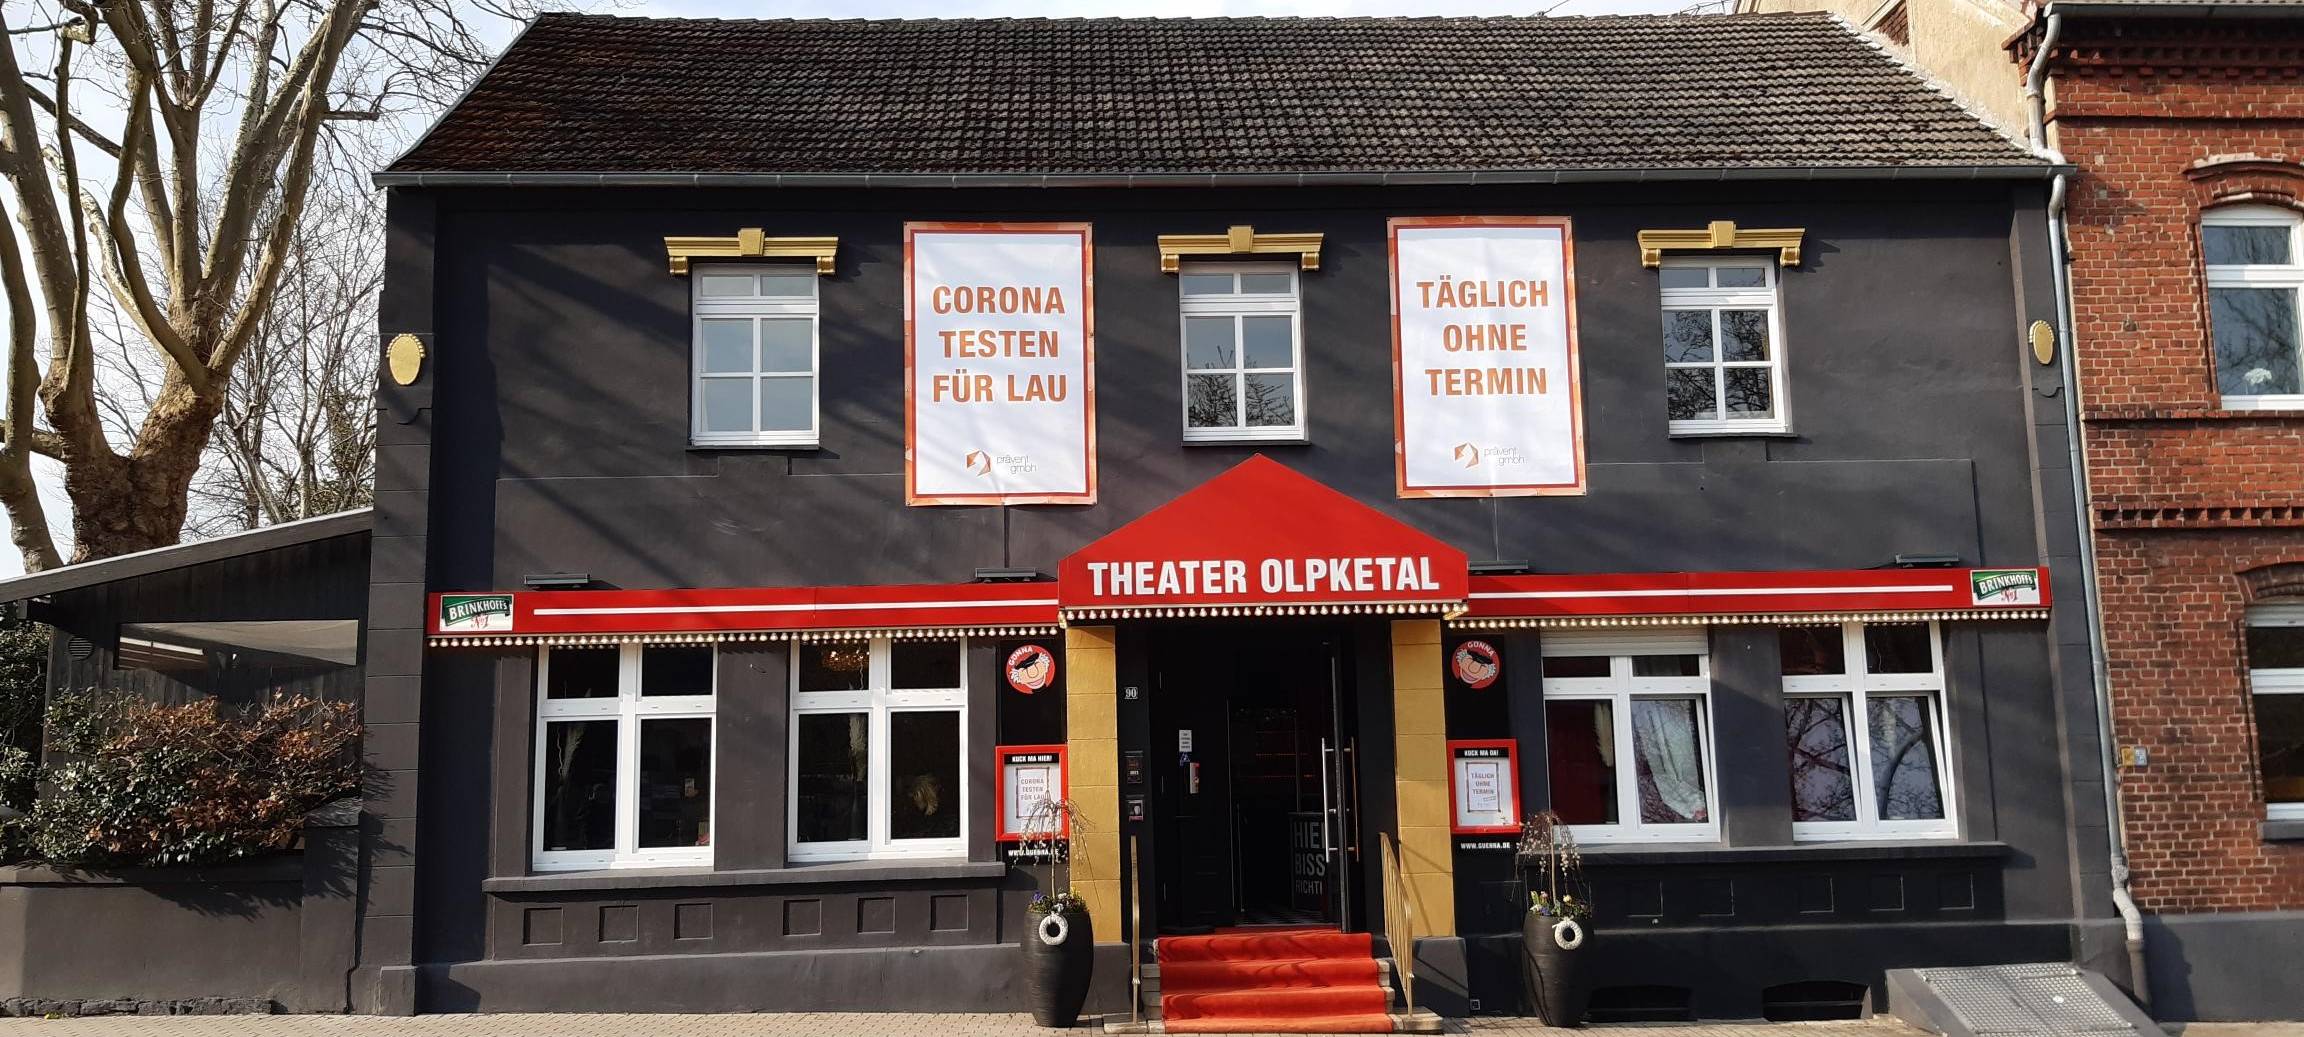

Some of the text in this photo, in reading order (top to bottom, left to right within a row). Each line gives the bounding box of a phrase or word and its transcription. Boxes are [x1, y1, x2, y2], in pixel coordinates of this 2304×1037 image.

[932, 285, 1066, 315] CORONA
[1416, 274, 1549, 309] TÄGLICH
[938, 330, 1059, 359] TESTEN
[1443, 323, 1528, 353] OHNE
[932, 367, 1067, 403] FÜR LAU
[1425, 367, 1548, 397] TERMIN
[996, 454, 1029, 464] prävent
[1484, 446, 1517, 456] prävent
[1498, 456, 1525, 466] gmbh
[1010, 464, 1037, 474] gmbh
[1087, 555, 1440, 597] THEATER OLPKETAL
[1125, 688, 1137, 698] 90
